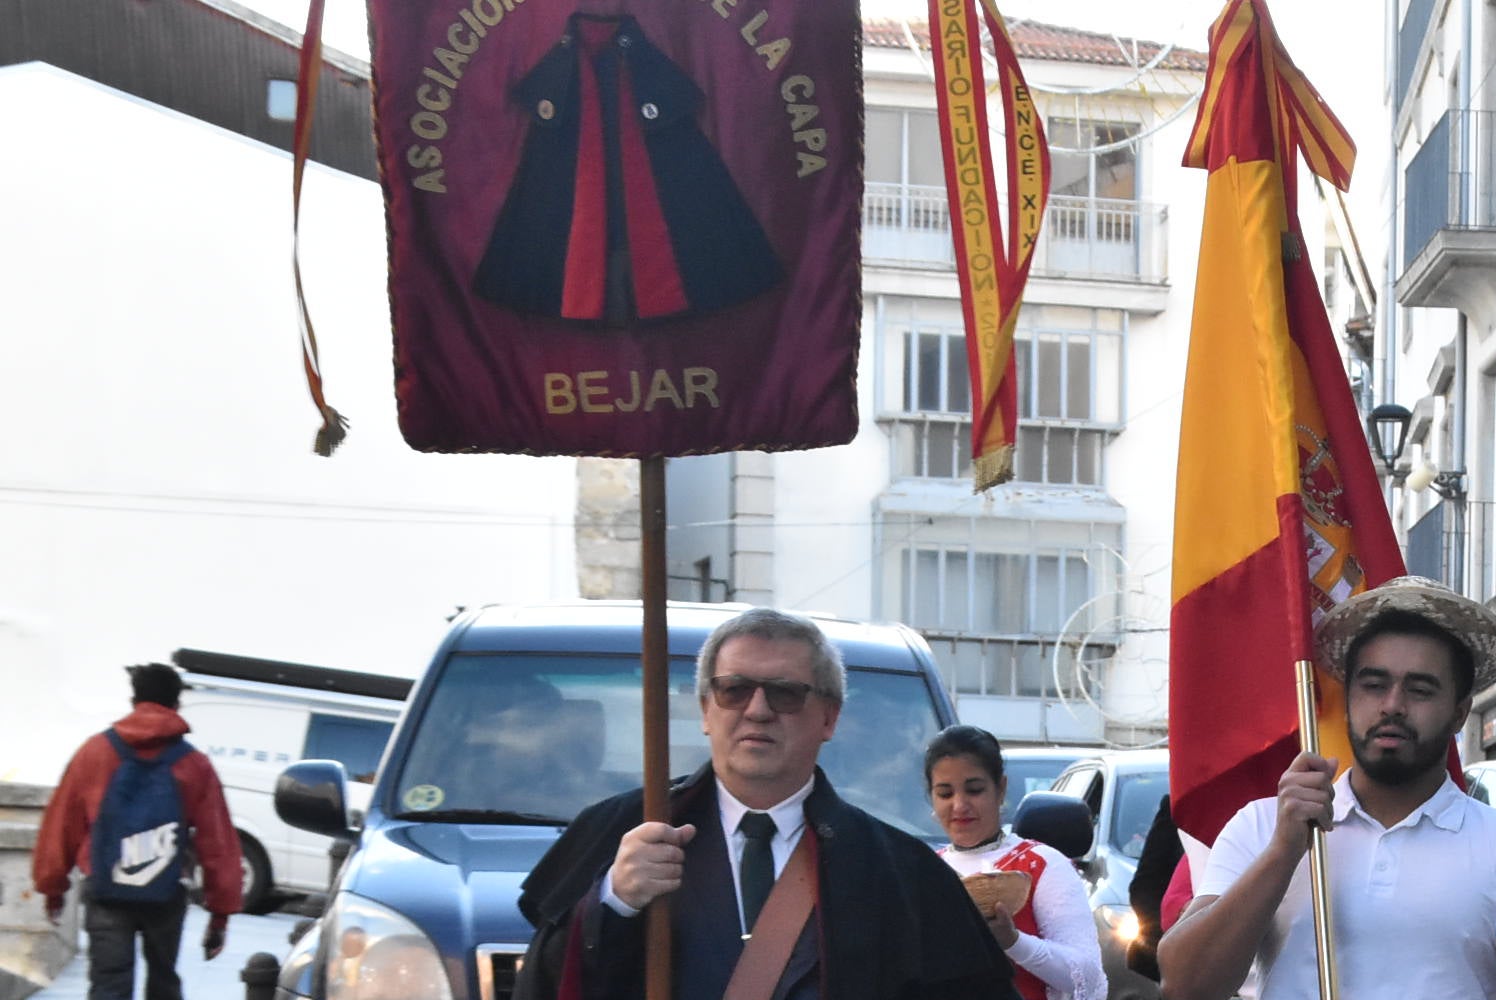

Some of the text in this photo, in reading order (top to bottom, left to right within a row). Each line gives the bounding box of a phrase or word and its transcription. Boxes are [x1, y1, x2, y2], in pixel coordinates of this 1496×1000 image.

[407, 0, 828, 194] ASOCIACIO LA CAPA
[1022, 194, 1038, 249] XIX
[543, 366, 721, 415] BEJAR
